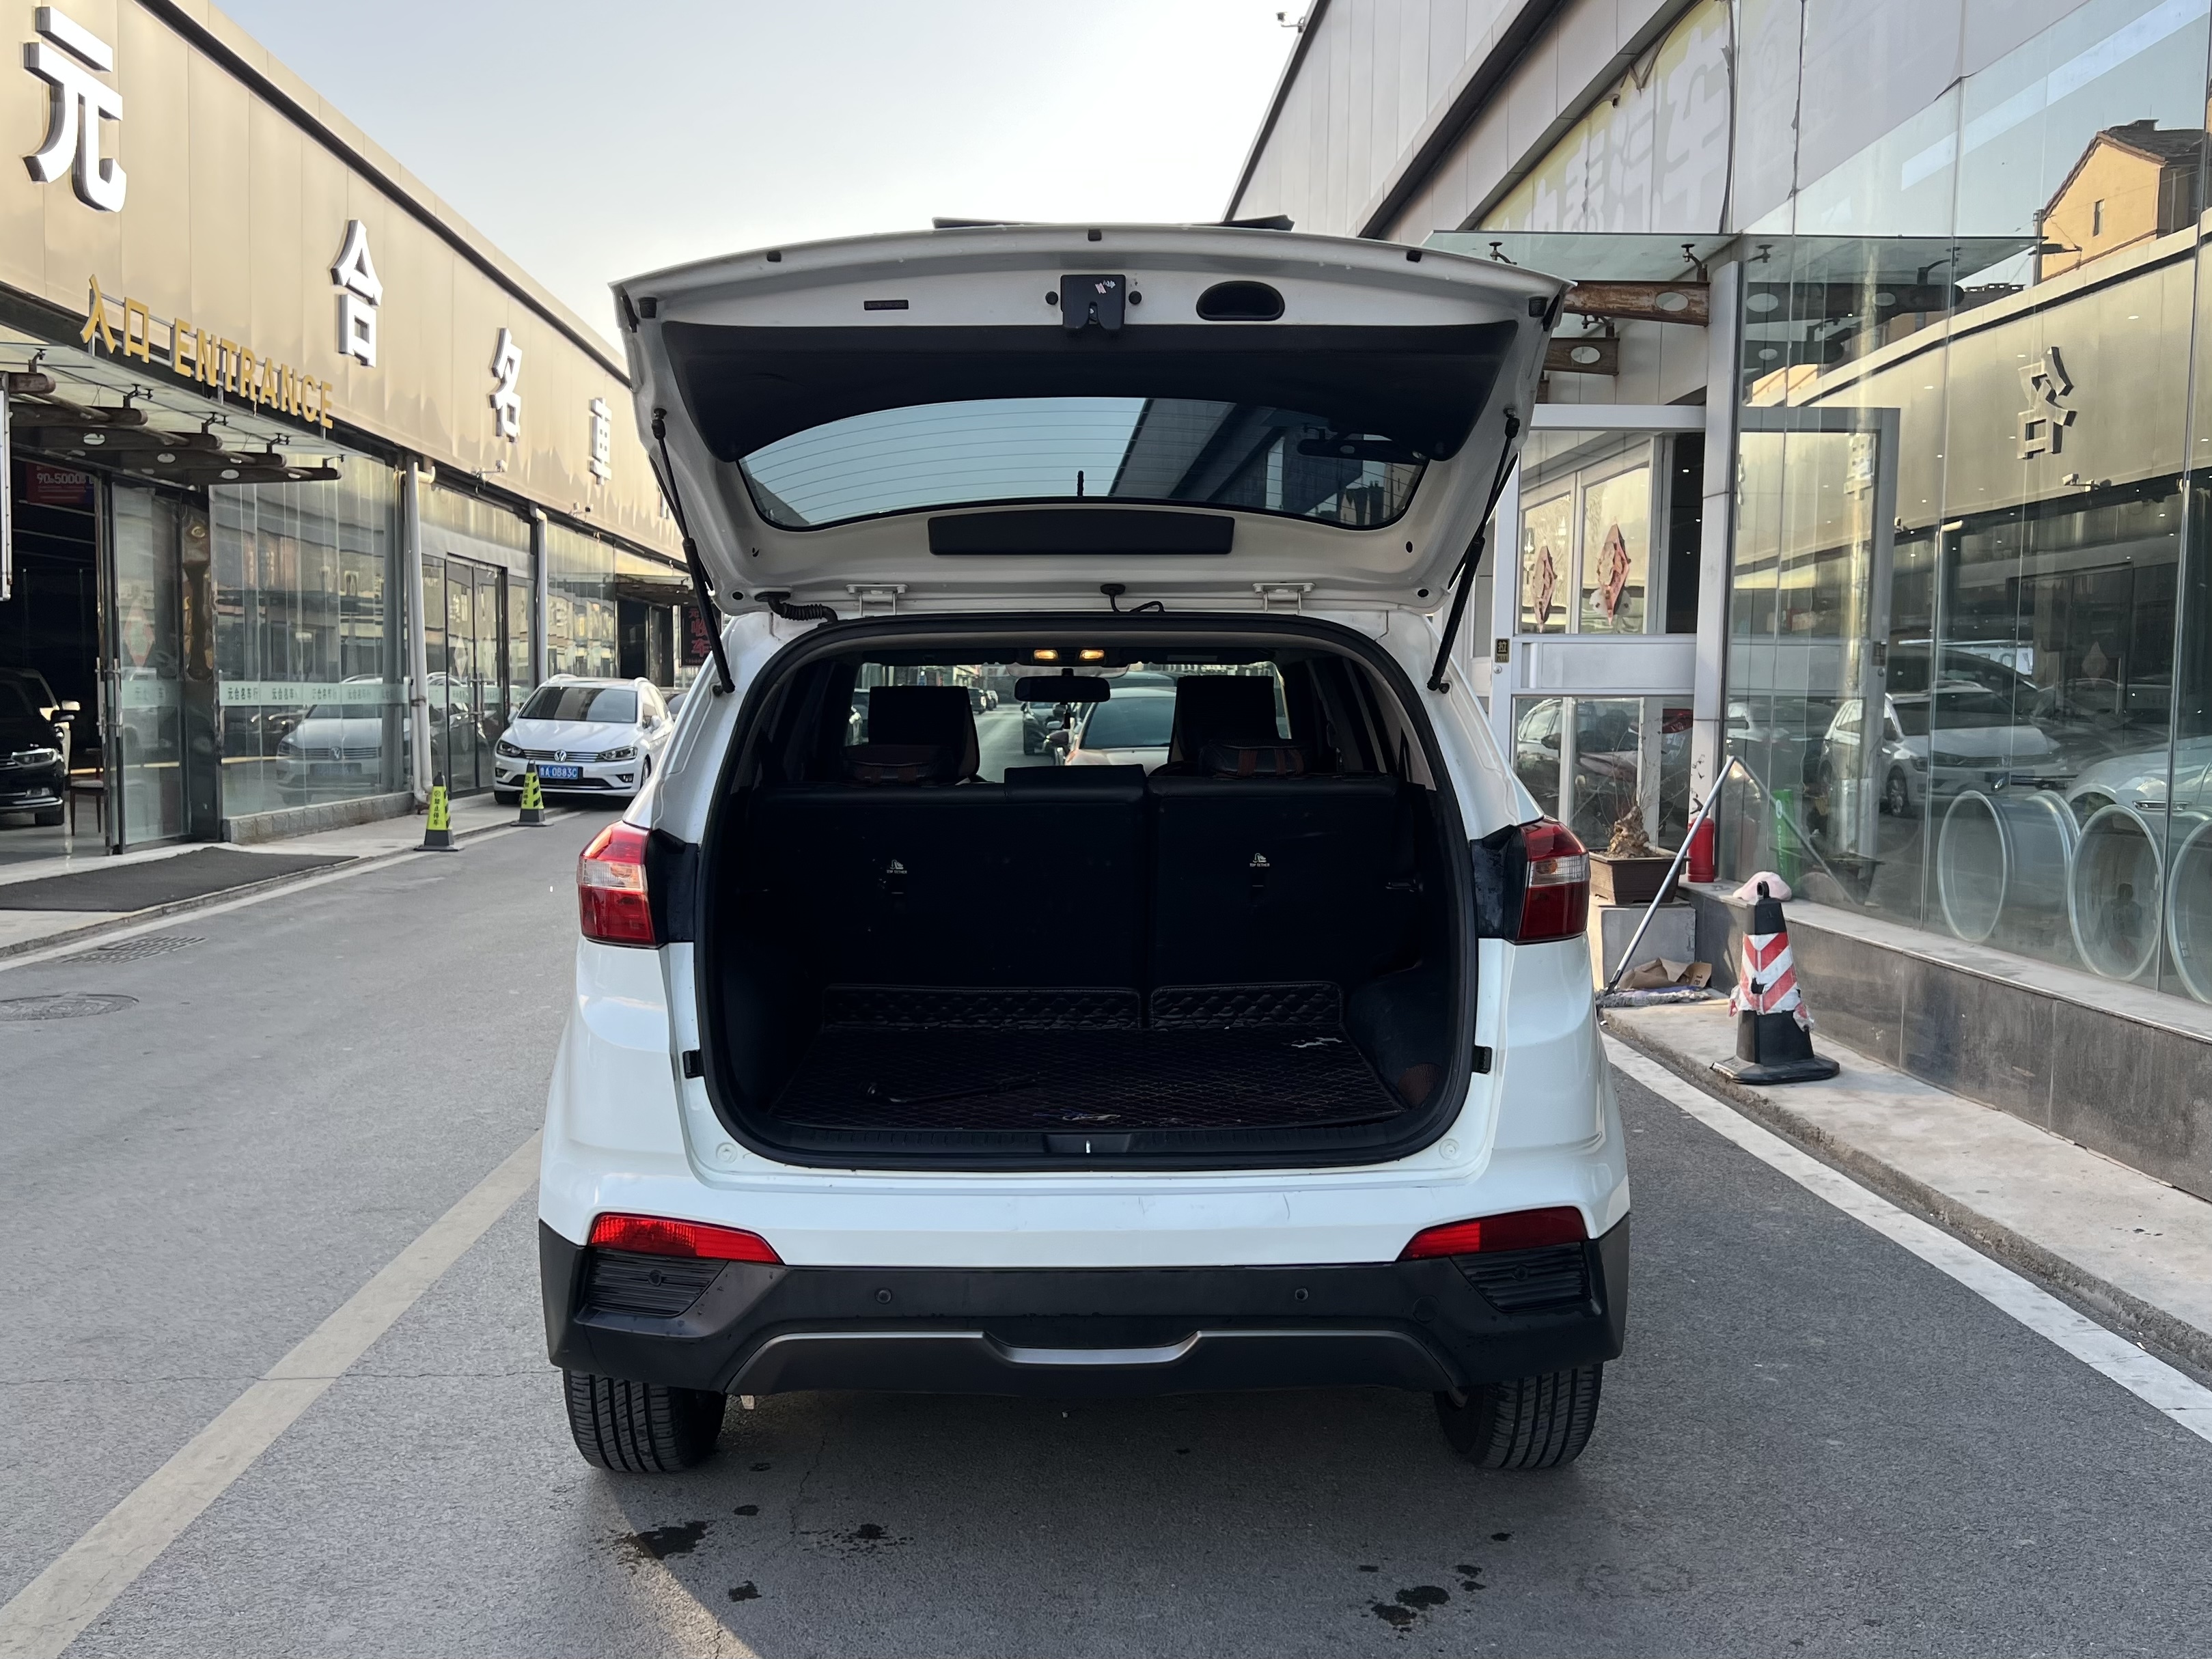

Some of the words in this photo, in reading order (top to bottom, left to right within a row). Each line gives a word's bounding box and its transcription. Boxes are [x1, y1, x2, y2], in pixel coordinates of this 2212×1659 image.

[80, 274, 150, 364] 入口
[172, 318, 333, 429] ENTRANCE
[1497, 641, 1507, 652] 拉
